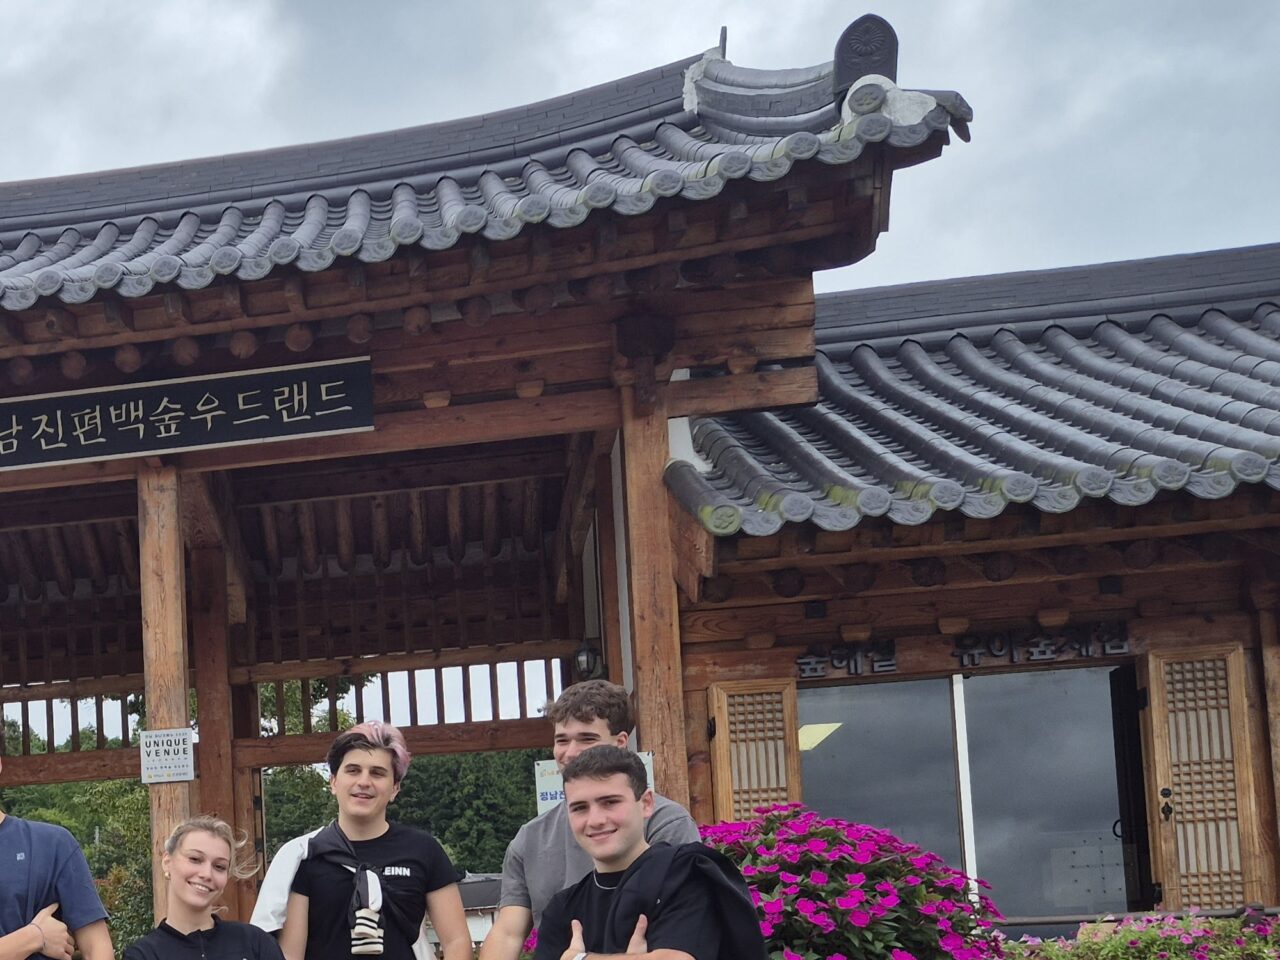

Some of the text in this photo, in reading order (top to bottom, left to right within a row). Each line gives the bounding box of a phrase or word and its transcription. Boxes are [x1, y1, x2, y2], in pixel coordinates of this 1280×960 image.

[145, 738, 188, 748] UNIQUE
[145, 747, 188, 757] VENUE
[383, 866, 411, 877] EINN
